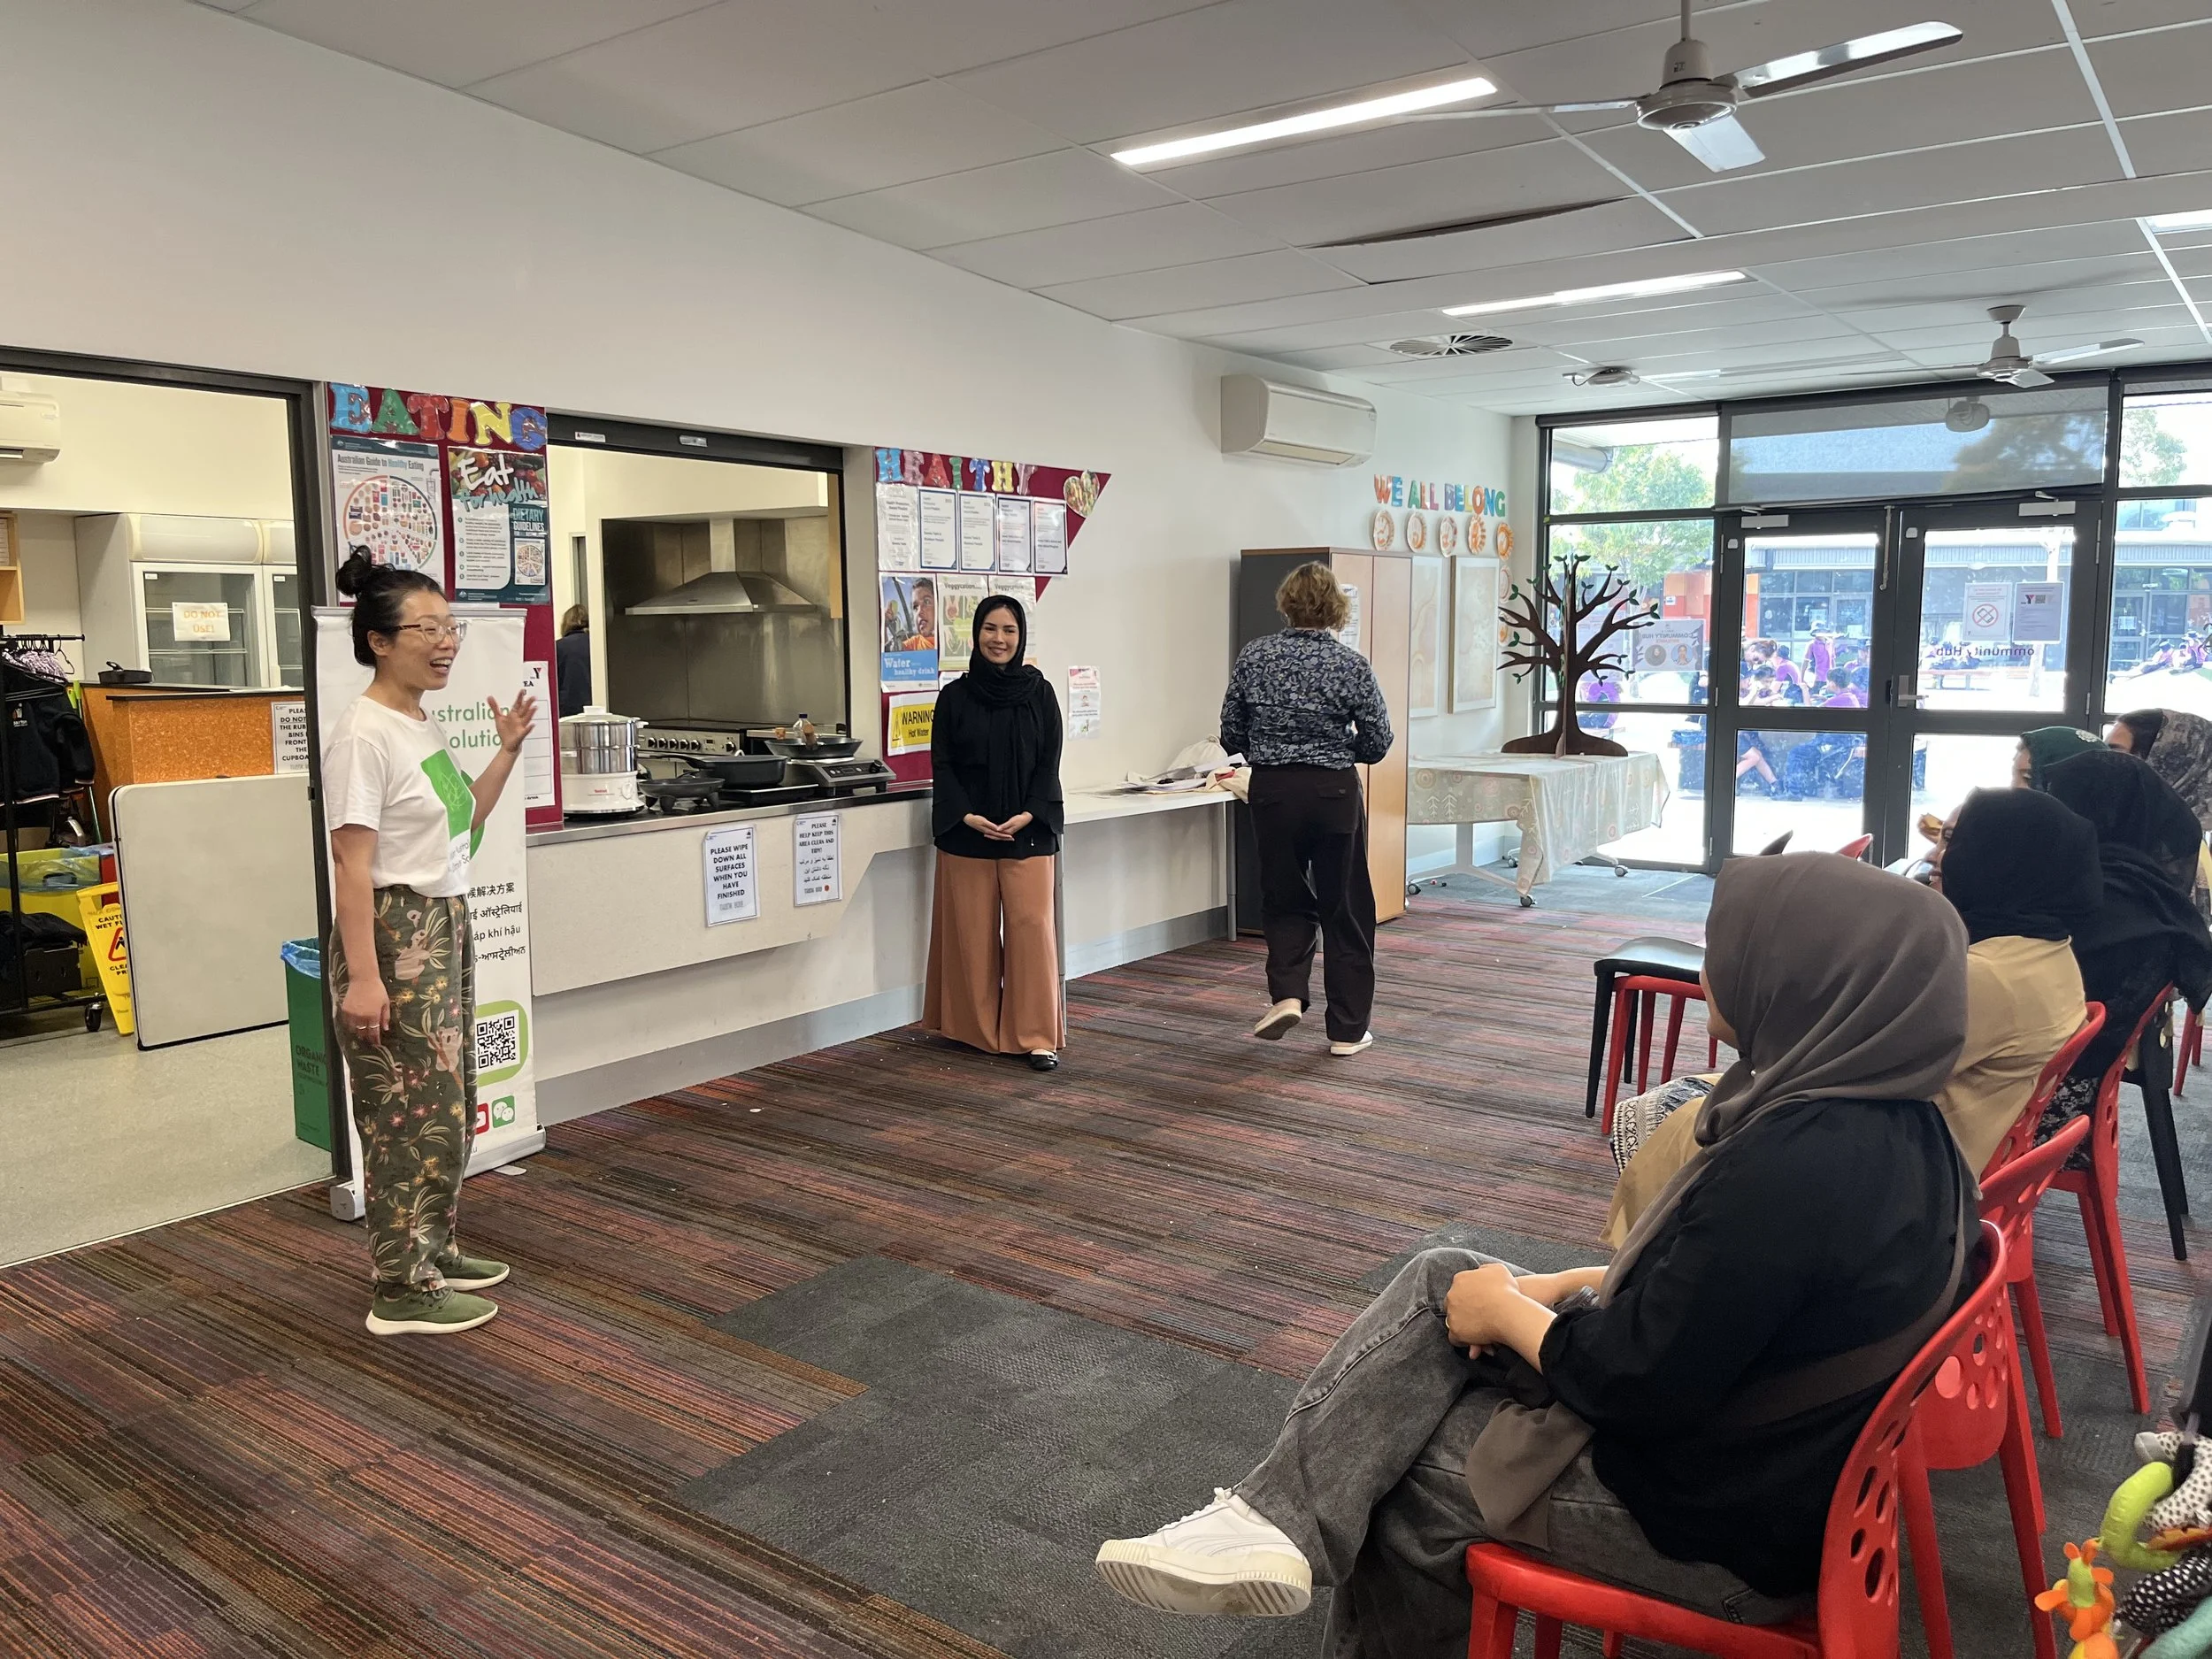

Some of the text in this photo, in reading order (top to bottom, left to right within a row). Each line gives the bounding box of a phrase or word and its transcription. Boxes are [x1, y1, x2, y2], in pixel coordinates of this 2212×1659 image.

[329, 381, 548, 451] EATING
[365, 456, 381, 467] Guide
[381, 458, 388, 467] to
[408, 460, 425, 472] Eating
[457, 453, 514, 491] Eat
[459, 476, 539, 512] for health
[1374, 473, 1506, 517] WE ALL BELONG
[512, 507, 544, 522] DIETARY
[512, 520, 545, 531] GUIDELINES
[884, 657, 911, 668] Water
[894, 668, 917, 677] healthy
[432, 702, 510, 722] stralian
[918, 728, 929, 737] Water
[449, 729, 502, 749] olutio
[710, 843, 749, 855] PLEASE WIPE
[713, 855, 734, 864] DOWN
[715, 862, 746, 872] SURFACES
[713, 873, 733, 882] WHEN
[717, 889, 745, 900] FINISHED
[98, 914, 123, 923] CAUTI
[473, 925, 520, 941] áp khí hậu
